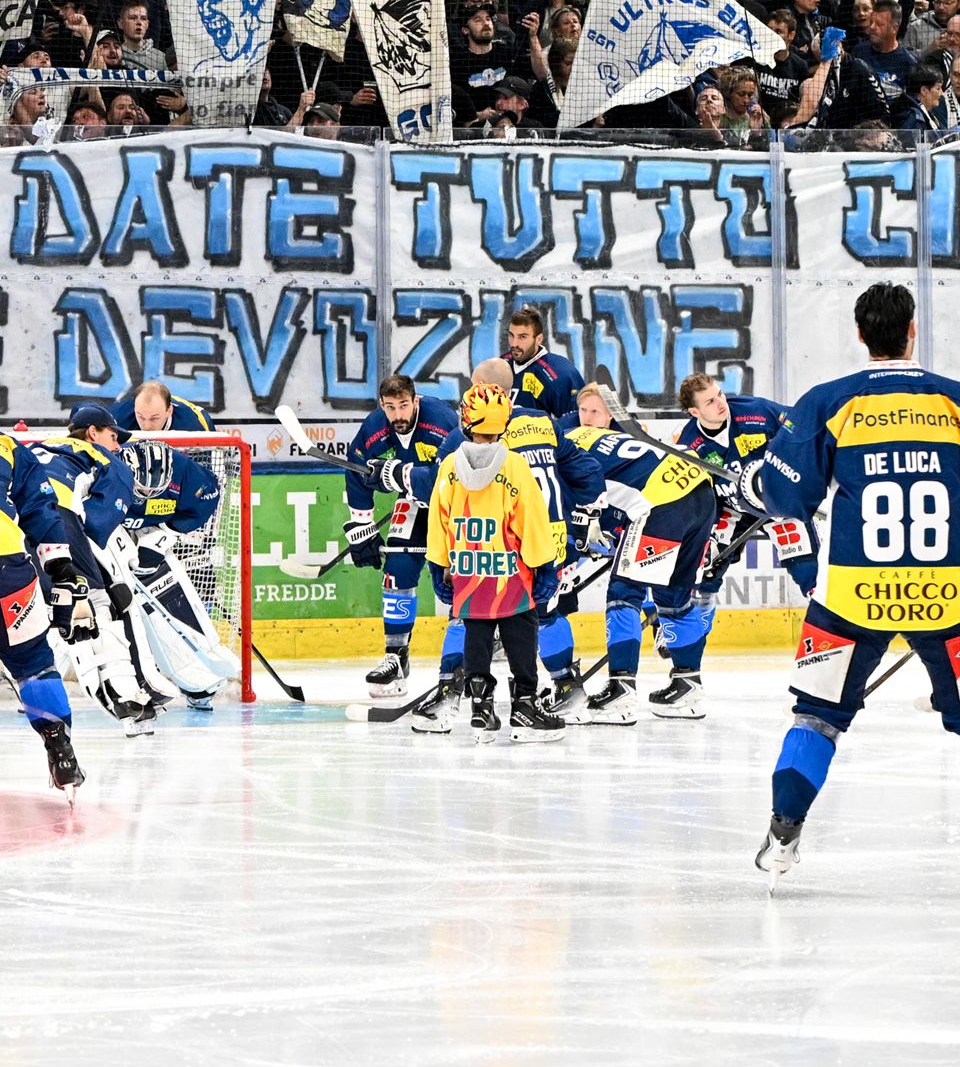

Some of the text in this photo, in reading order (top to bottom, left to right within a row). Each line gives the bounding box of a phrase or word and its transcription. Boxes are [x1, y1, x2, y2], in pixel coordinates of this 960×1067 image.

[10, 143, 354, 274] DATE
[390, 151, 801, 271] TUTTO
[52, 283, 755, 412] DEVOZIONE
[864, 451, 941, 476] DE LUCA
[122, 517, 144, 530] 30
[453, 517, 497, 543] TOP
[862, 481, 951, 563] 88
[879, 569, 936, 580] CAFFÈ
[254, 583, 337, 602] FREDDE
[855, 582, 958, 601] CHICCO
[867, 602, 944, 622] D'ORO
